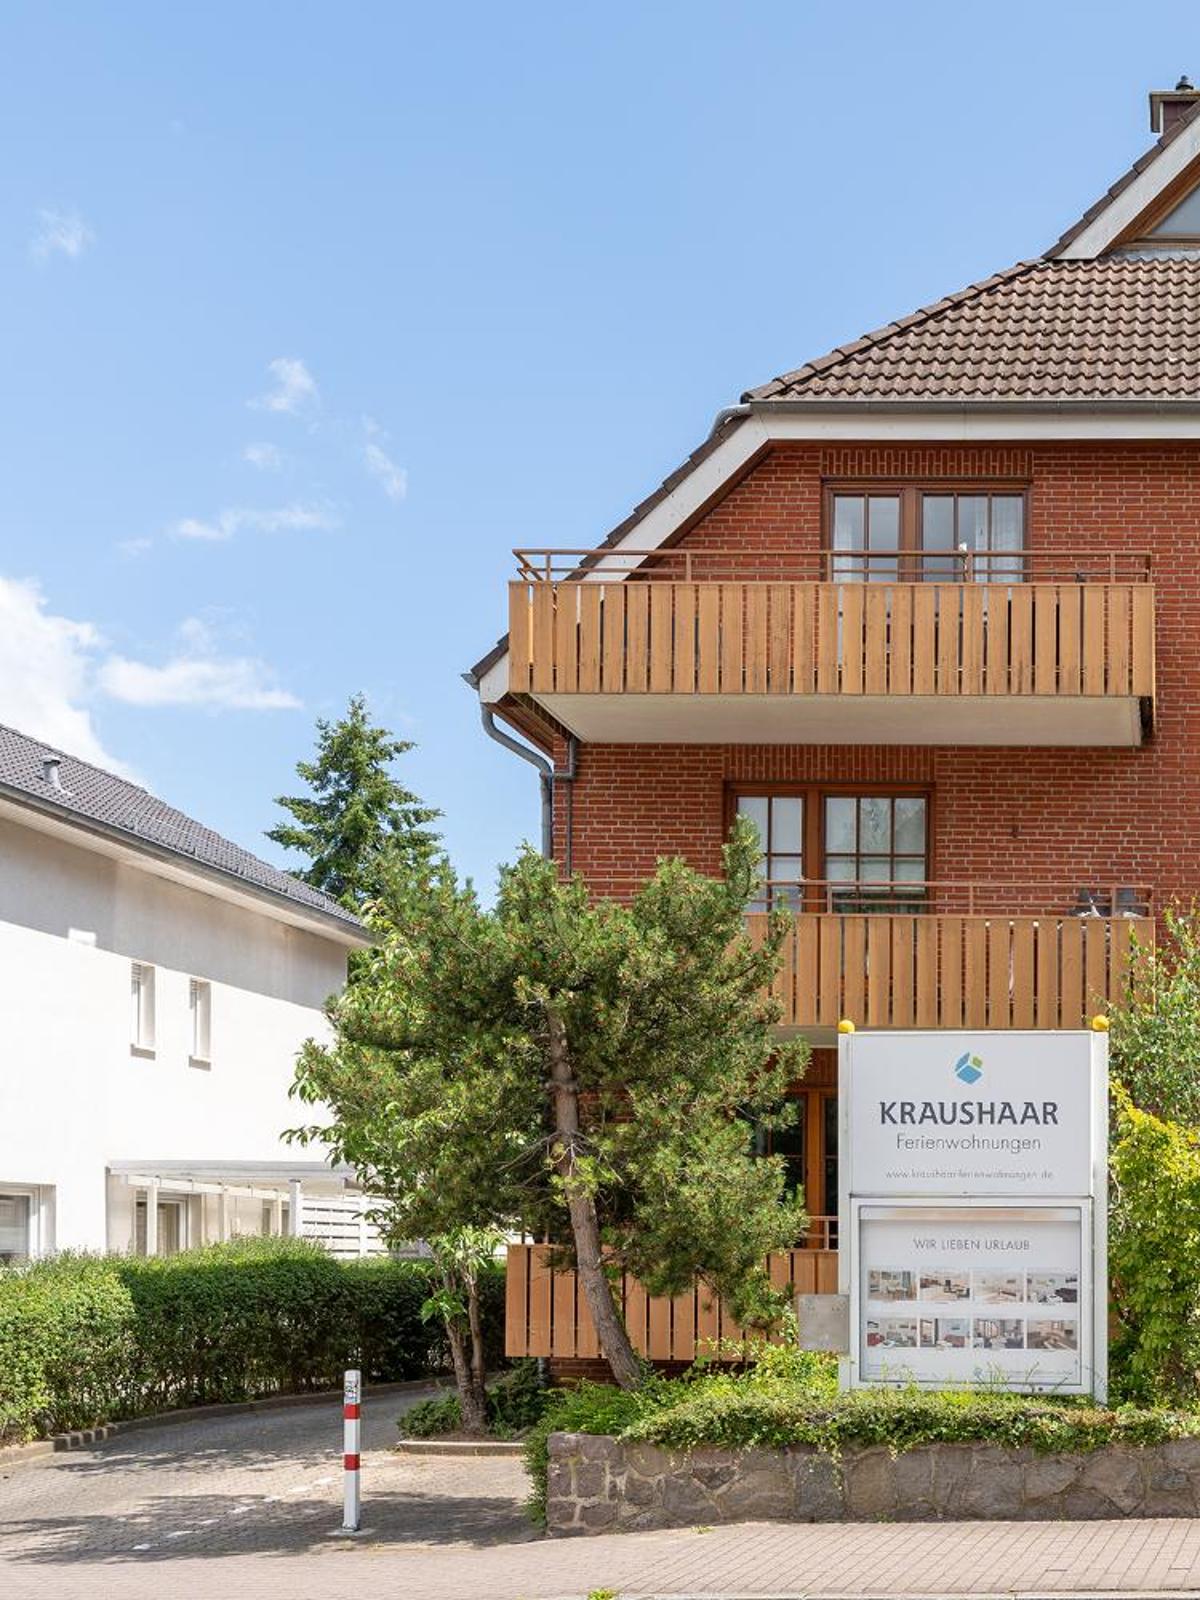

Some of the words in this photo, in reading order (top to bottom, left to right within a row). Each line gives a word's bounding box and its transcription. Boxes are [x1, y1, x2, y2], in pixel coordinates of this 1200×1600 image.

[880, 1101, 1059, 1125] KRAUSHAAR
[896, 1132, 1041, 1154] Ferienwohnungen
[912, 1238, 937, 1250] WIR
[941, 1239, 980, 1250] LIEBEN
[985, 1239, 1030, 1250] URLAUB
